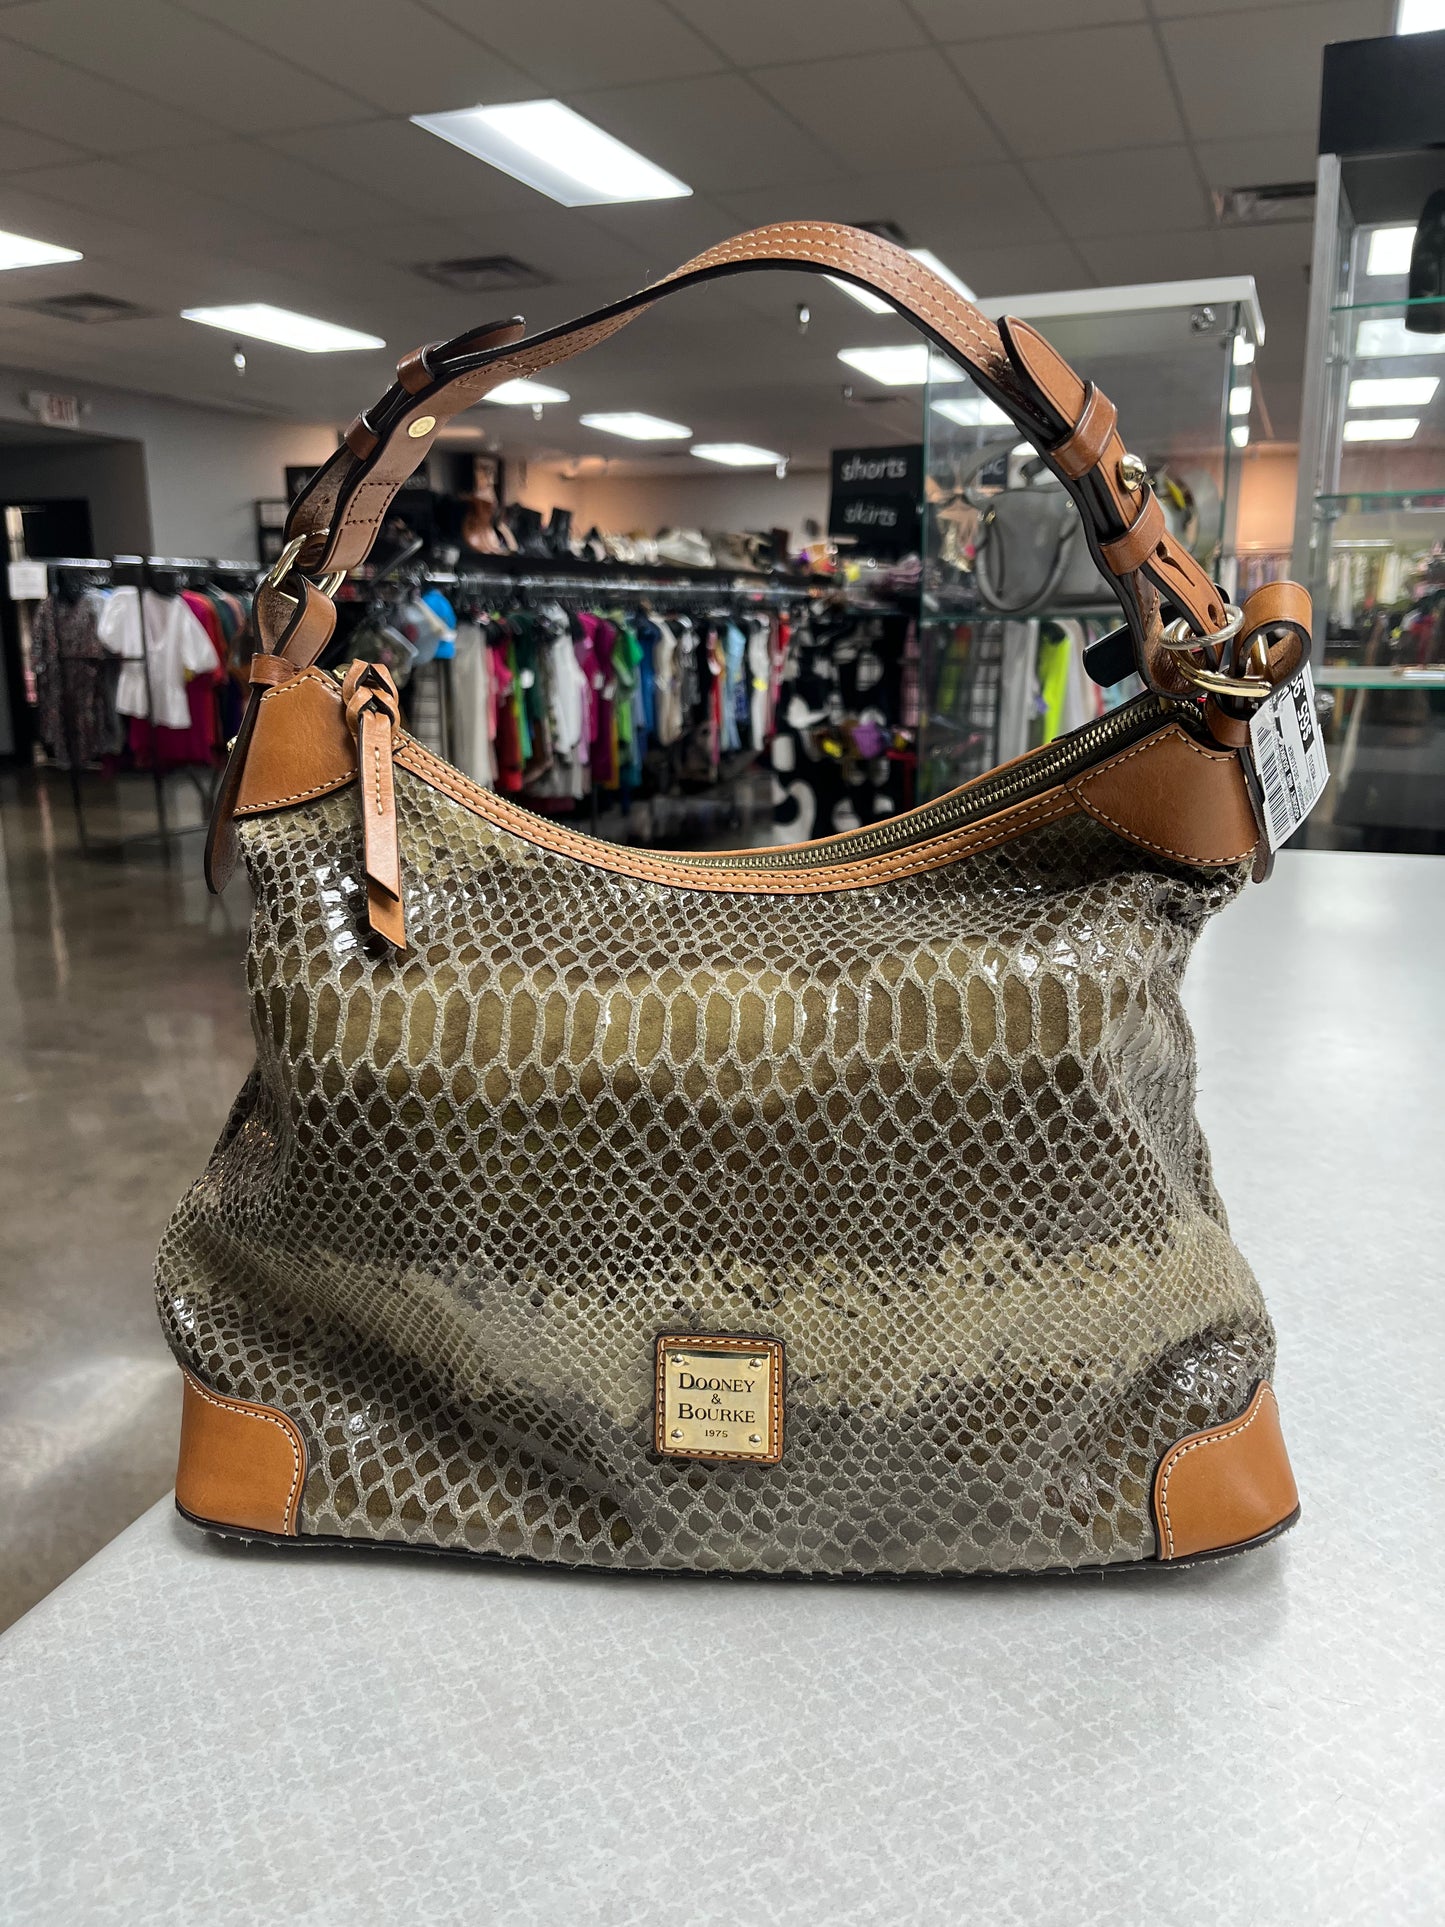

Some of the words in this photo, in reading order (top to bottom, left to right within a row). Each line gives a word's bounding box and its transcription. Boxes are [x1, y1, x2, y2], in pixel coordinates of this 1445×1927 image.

[47, 396, 76, 421] EXIT
[841, 456, 907, 481] shorts
[844, 502, 898, 527] skirts
[678, 1372, 755, 1393] DOONEY
[711, 1393, 722, 1404] &
[678, 1403, 755, 1423] BOURKE
[705, 1429, 728, 1438] 1975
